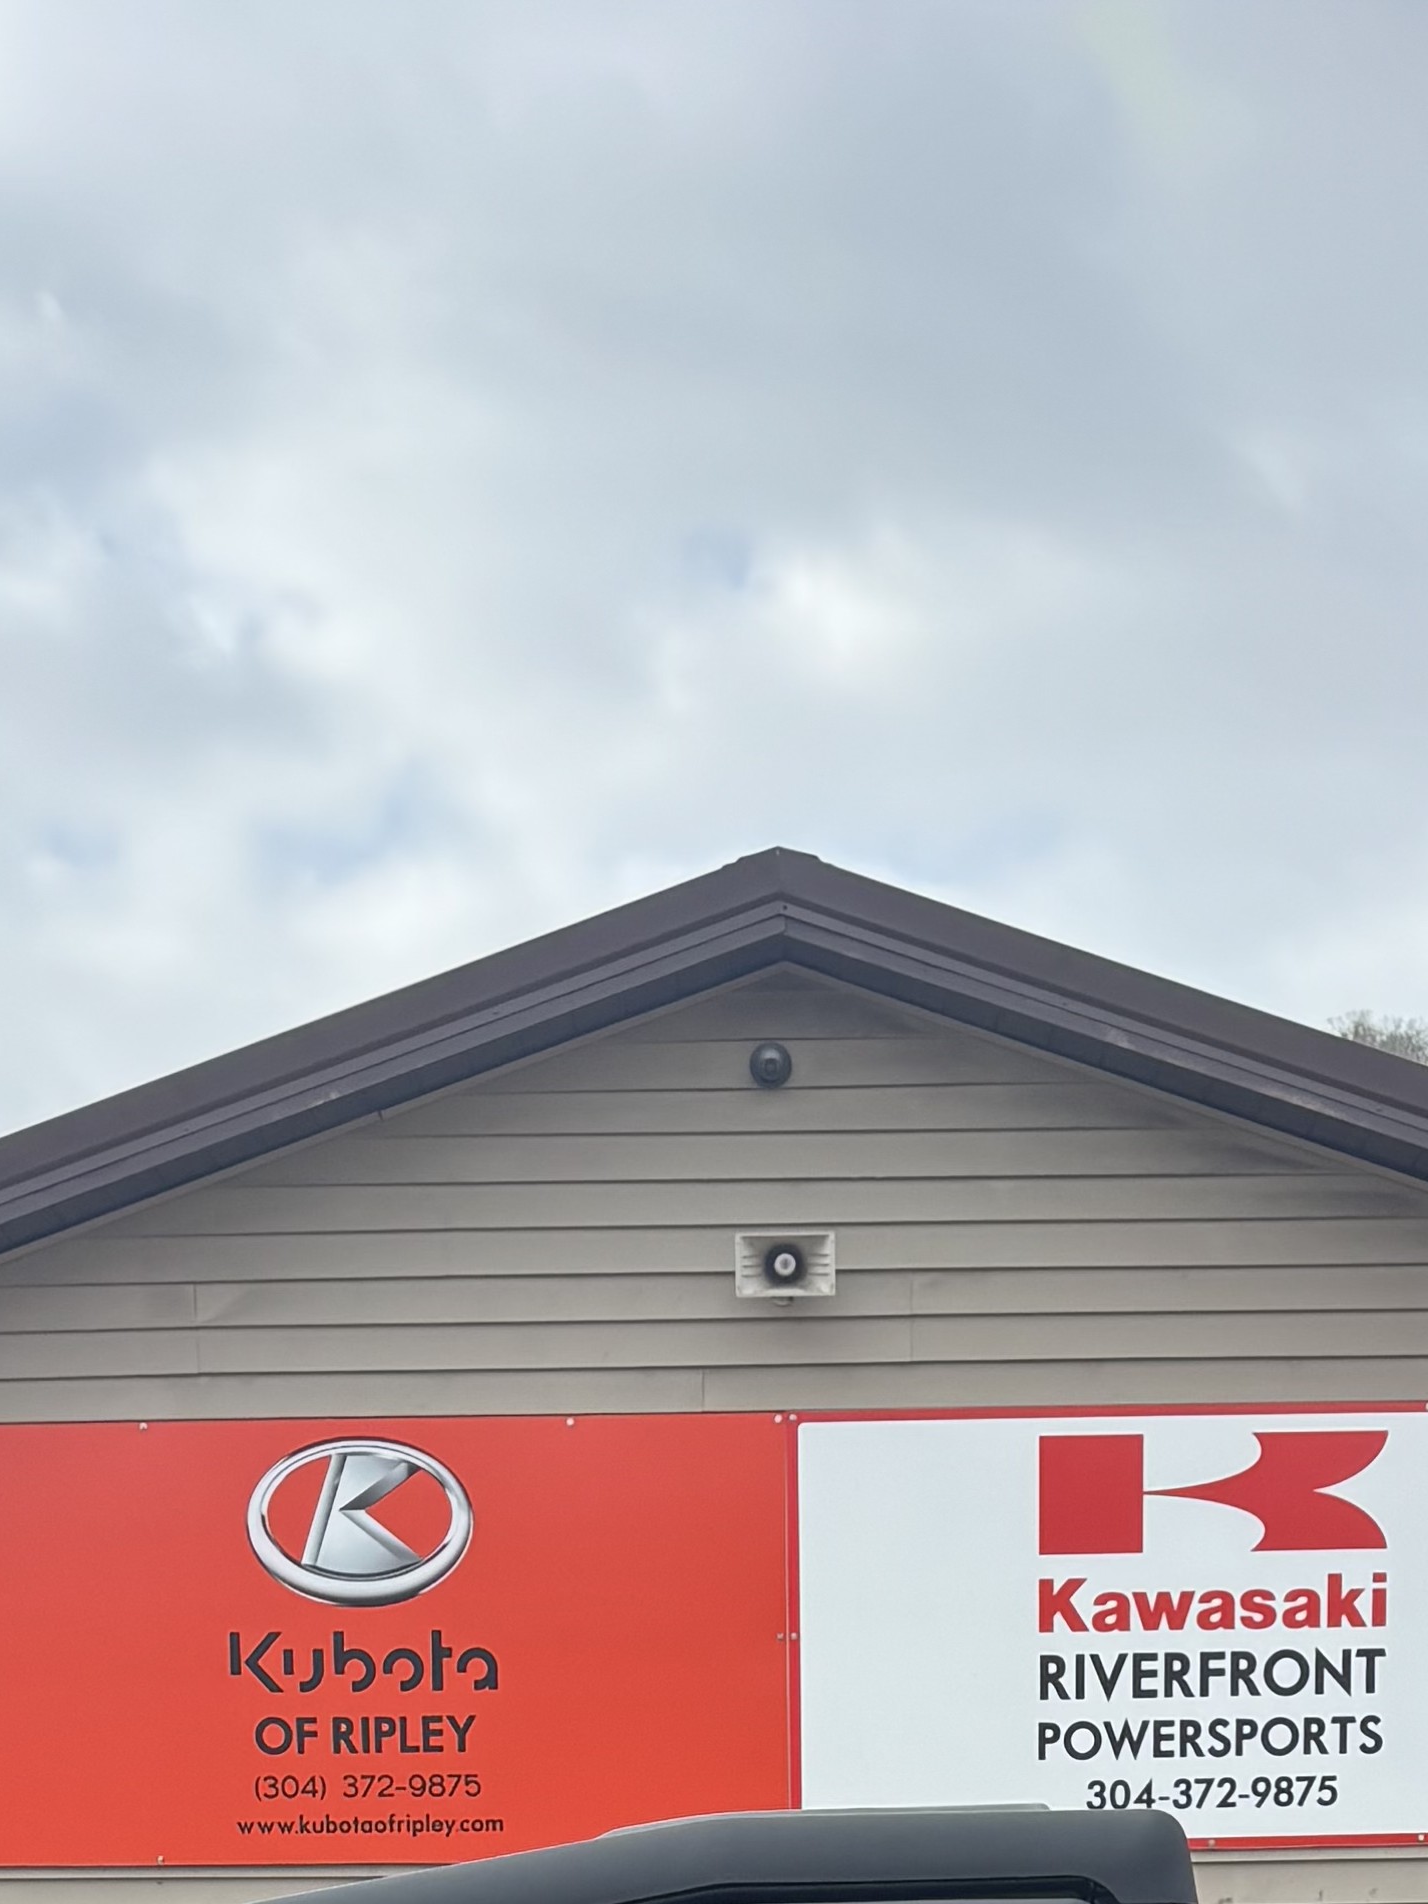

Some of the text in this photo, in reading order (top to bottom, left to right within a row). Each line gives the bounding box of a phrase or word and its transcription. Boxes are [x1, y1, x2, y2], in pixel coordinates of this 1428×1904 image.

[1038, 1572, 1388, 1633] Kawasaki
[229, 1629, 499, 1693] Kubota
[1039, 1647, 1387, 1702] RIVERFRONT
[255, 1715, 476, 1755] OF RIPLEY
[1037, 1715, 1384, 1761] POWERSPORTS
[254, 1773, 482, 1801] (304) 372-9875
[1086, 1775, 1339, 1810] 304-372-9875
[237, 1812, 505, 1838] www.kubotaofripley.com
